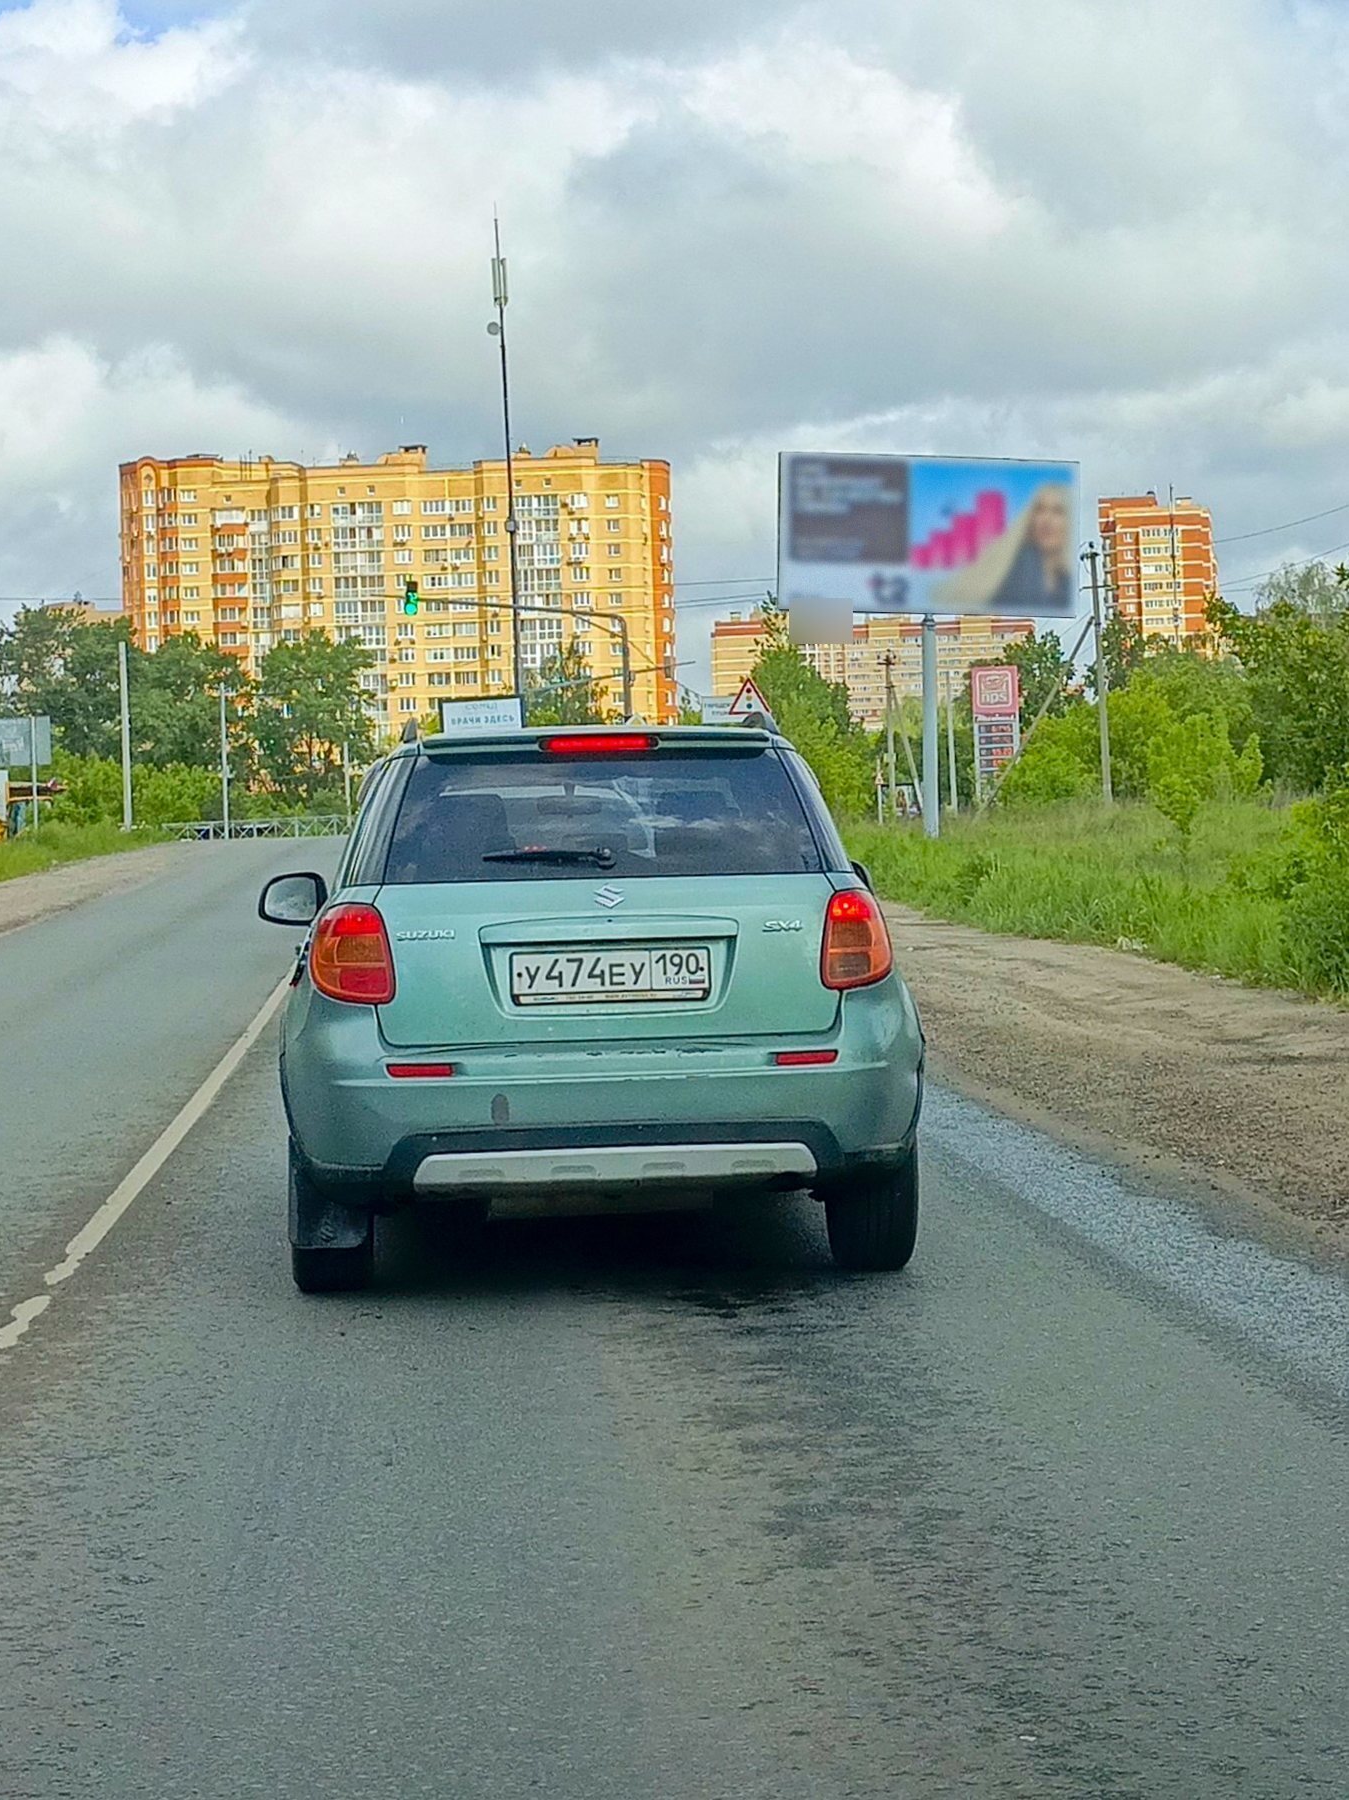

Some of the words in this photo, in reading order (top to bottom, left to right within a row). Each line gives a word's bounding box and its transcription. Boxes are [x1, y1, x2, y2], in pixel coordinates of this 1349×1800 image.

[484, 714, 515, 724] ЗДЕСЬ
[762, 919, 803, 933] SX4
[396, 929, 456, 942] SUZUKI
[525, 956, 646, 989] У474ЕУ
[654, 952, 700, 976] 190
[664, 976, 688, 985] RUS
